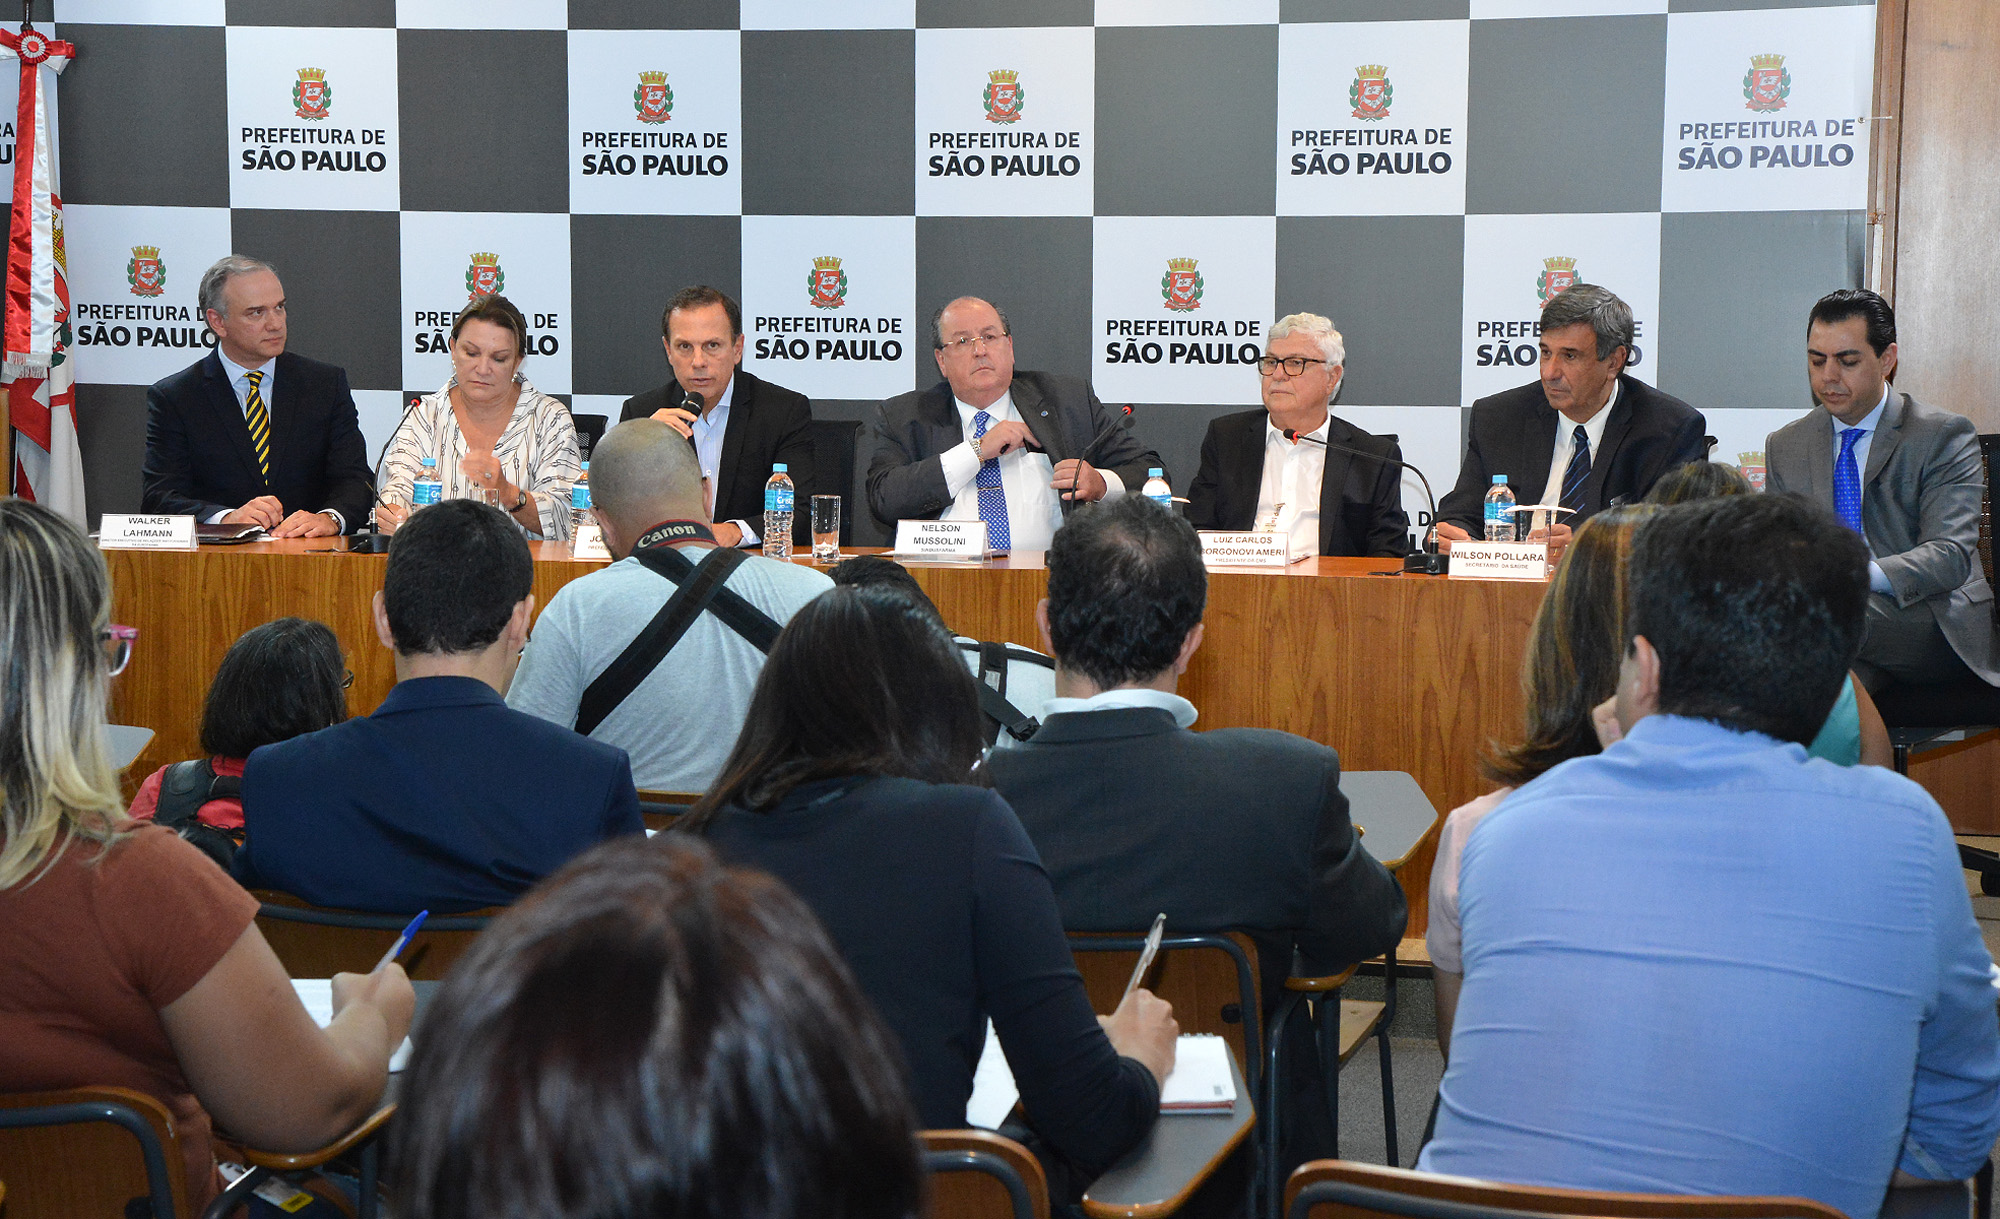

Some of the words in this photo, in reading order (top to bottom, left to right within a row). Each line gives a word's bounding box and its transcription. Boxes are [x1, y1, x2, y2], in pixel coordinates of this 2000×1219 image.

[242, 128, 355, 144] PREFEITURA
[362, 130, 385, 144] DE
[1292, 129, 1418, 146] PREFEITURA
[1425, 129, 1451, 145] DE
[1680, 120, 1817, 140] PREFEITURA
[1825, 119, 1855, 136] DE
[583, 132, 697, 148] PREFEITURA
[704, 133, 727, 148] DE
[930, 133, 1048, 148] PREFEITURA
[1055, 132, 1079, 148] DE
[243, 144, 295, 170] SÃO
[302, 151, 386, 172] PAULO
[583, 149, 636, 175] SÃO
[643, 155, 728, 176] PAULO
[929, 150, 984, 176] SÃO
[991, 155, 1080, 176] PAULO
[1291, 148, 1349, 175] SÃO
[1357, 152, 1451, 174] PAULO
[1678, 141, 1742, 170] SÃO
[1750, 144, 1854, 168] PAULO
[78, 304, 190, 321] PREFEITURA
[535, 313, 558, 328] DE
[756, 317, 871, 333] PREFEITURA
[878, 318, 901, 333] DE
[1107, 320, 1227, 336] PREFEITURA
[1235, 321, 1260, 336] DE
[78, 320, 131, 346] SÃO
[137, 327, 219, 348] PAULO
[415, 328, 451, 353] SÃ
[756, 333, 809, 360] SÃO
[816, 340, 902, 361] PAULO
[1106, 337, 1163, 364] SÃO
[1170, 343, 1260, 364] PAULO
[1477, 339, 1538, 366] SÃO
[128, 517, 171, 525] WALKER
[921, 524, 961, 532] NELSON
[123, 529, 173, 537] LAHMANN
[637, 525, 696, 548] Canon
[913, 536, 966, 545] MUSSOLINI
[1213, 536, 1233, 544] LUIZ
[1235, 536, 1273, 544] CARLOS
[1450, 551, 1492, 560] WILSON
[1494, 552, 1545, 562] POLLARA
